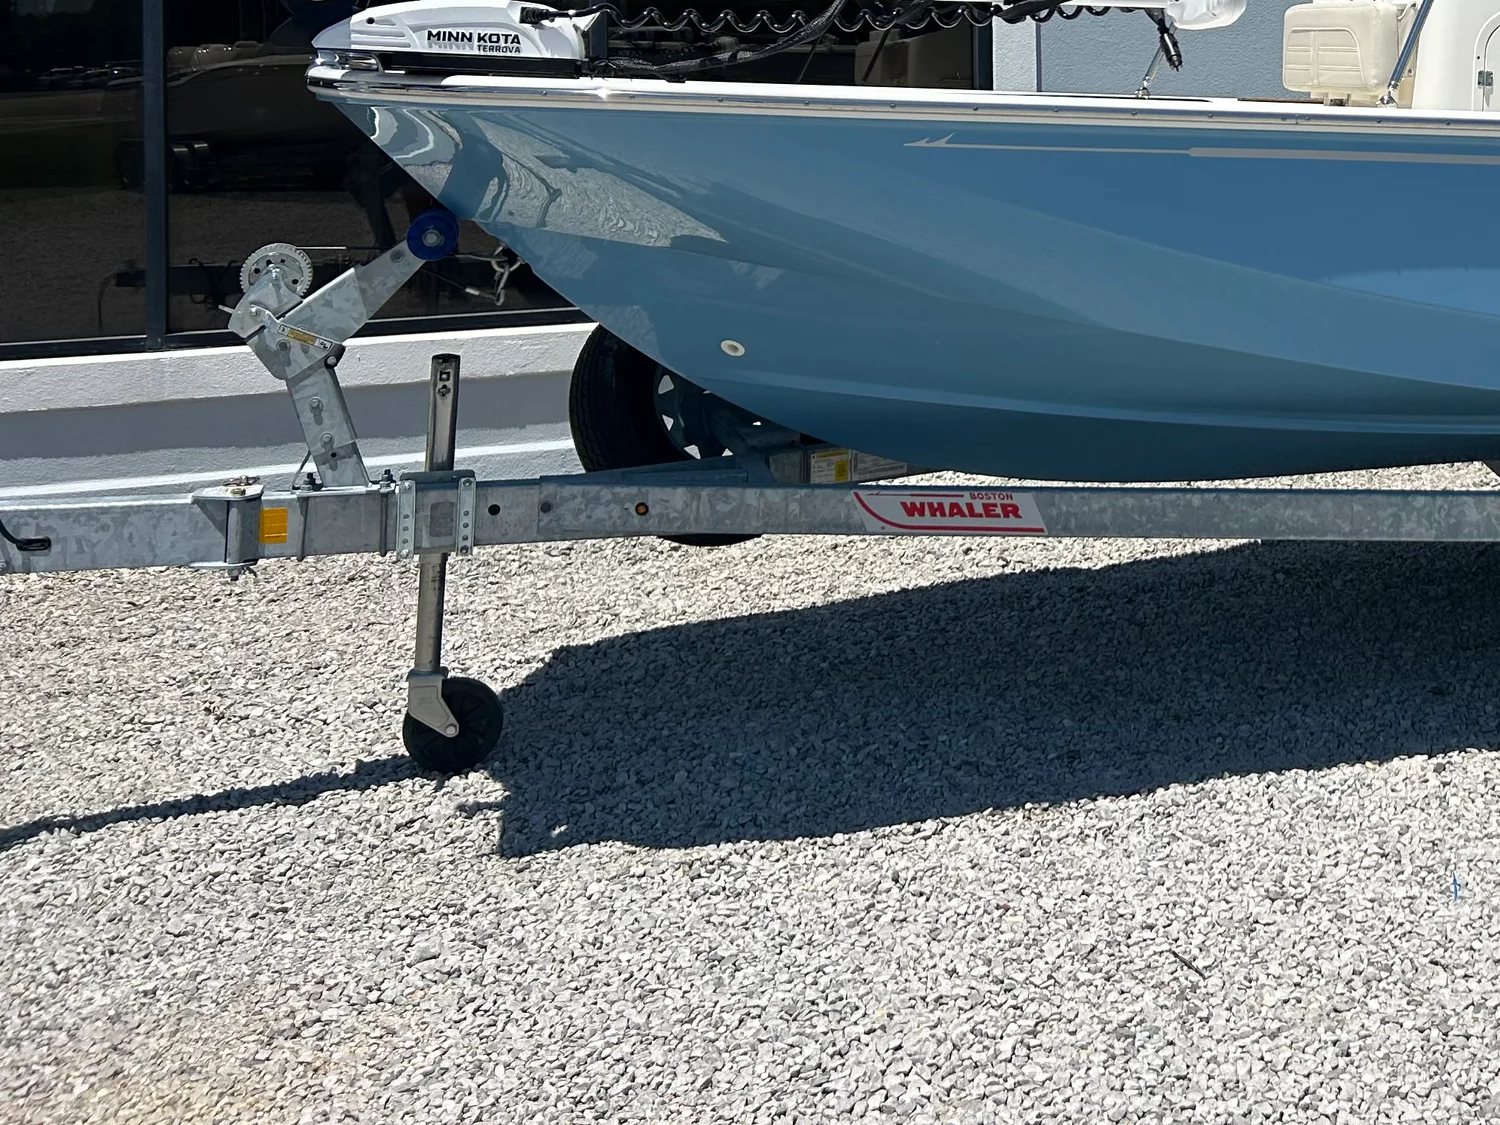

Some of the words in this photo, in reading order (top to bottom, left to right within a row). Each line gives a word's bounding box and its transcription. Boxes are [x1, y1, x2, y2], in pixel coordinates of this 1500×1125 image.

[427, 30, 473, 43] MINN
[477, 32, 521, 45] KOTA
[477, 44, 521, 53] TERROVA
[969, 492, 1013, 501] BOSTON
[900, 501, 1022, 519] WHALER
